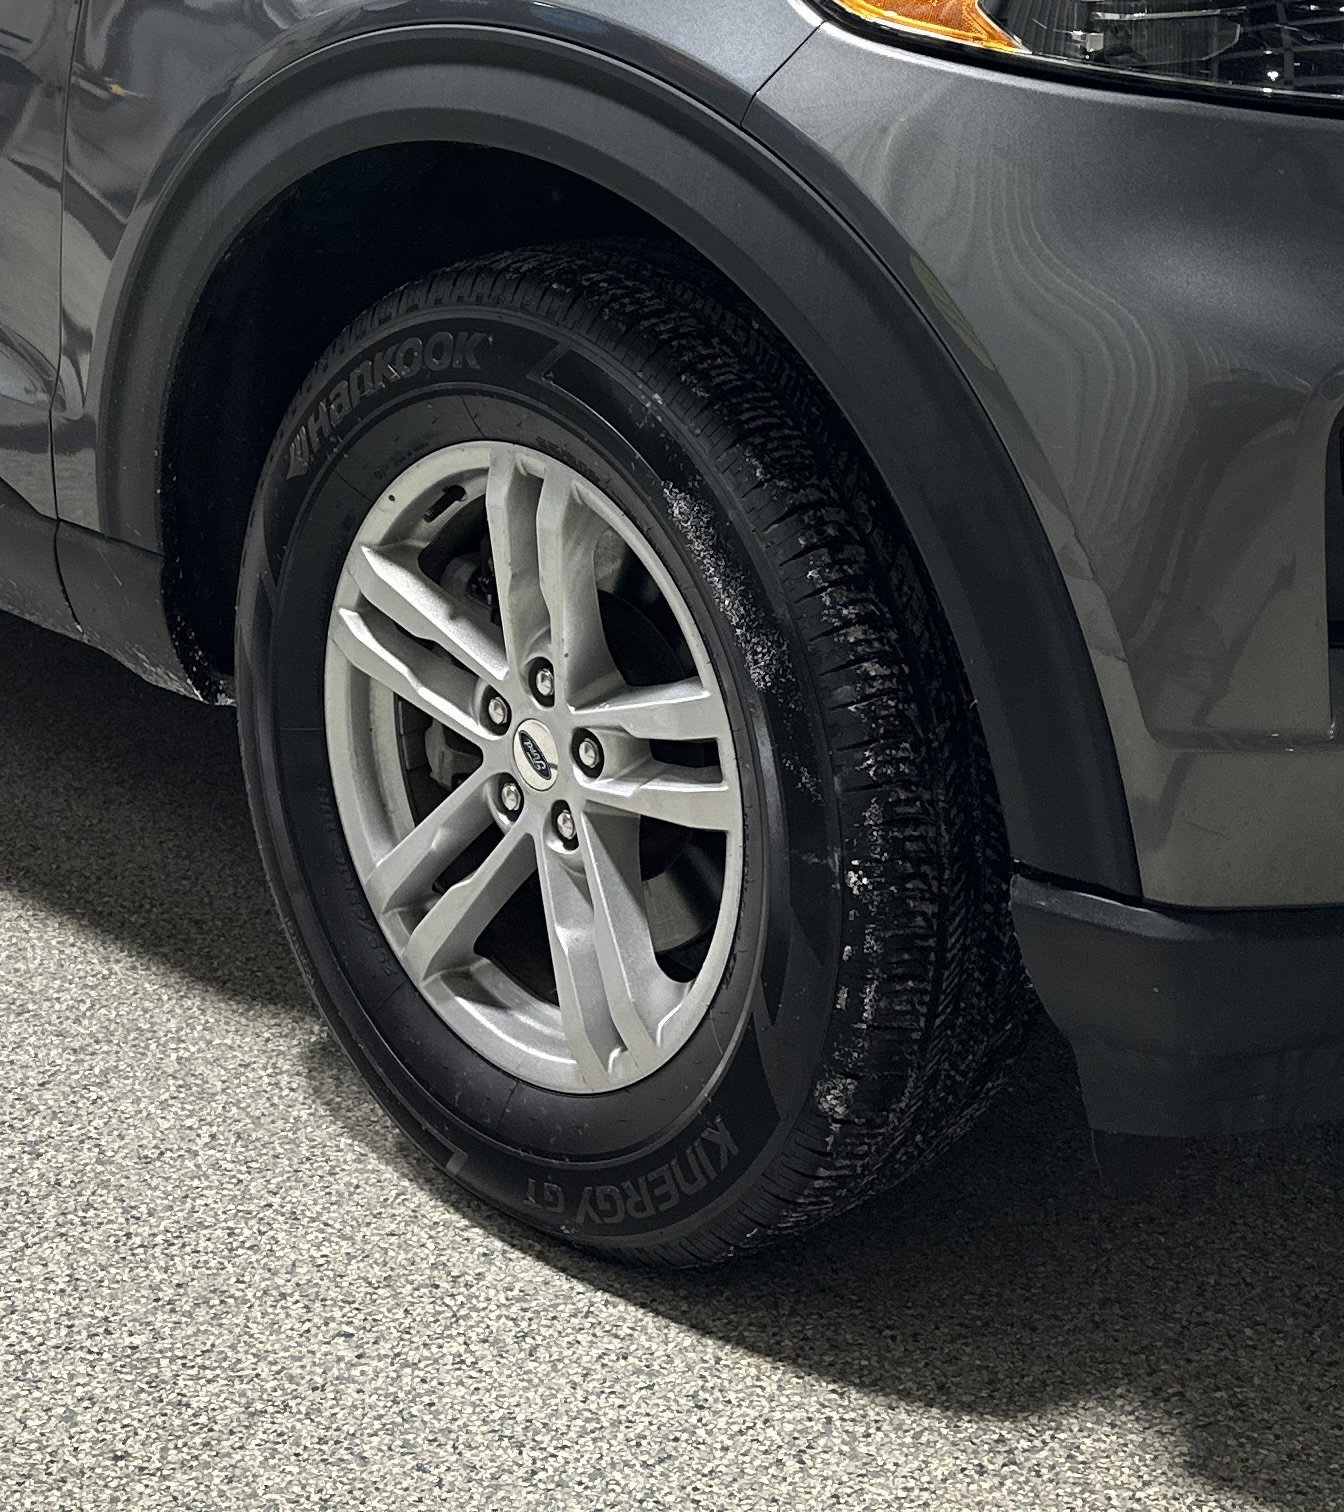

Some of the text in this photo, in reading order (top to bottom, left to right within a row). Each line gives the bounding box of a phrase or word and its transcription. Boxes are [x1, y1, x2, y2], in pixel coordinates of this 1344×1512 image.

[523, 740, 546, 771] Ford
[523, 1113, 740, 1225] KINERGY GT
